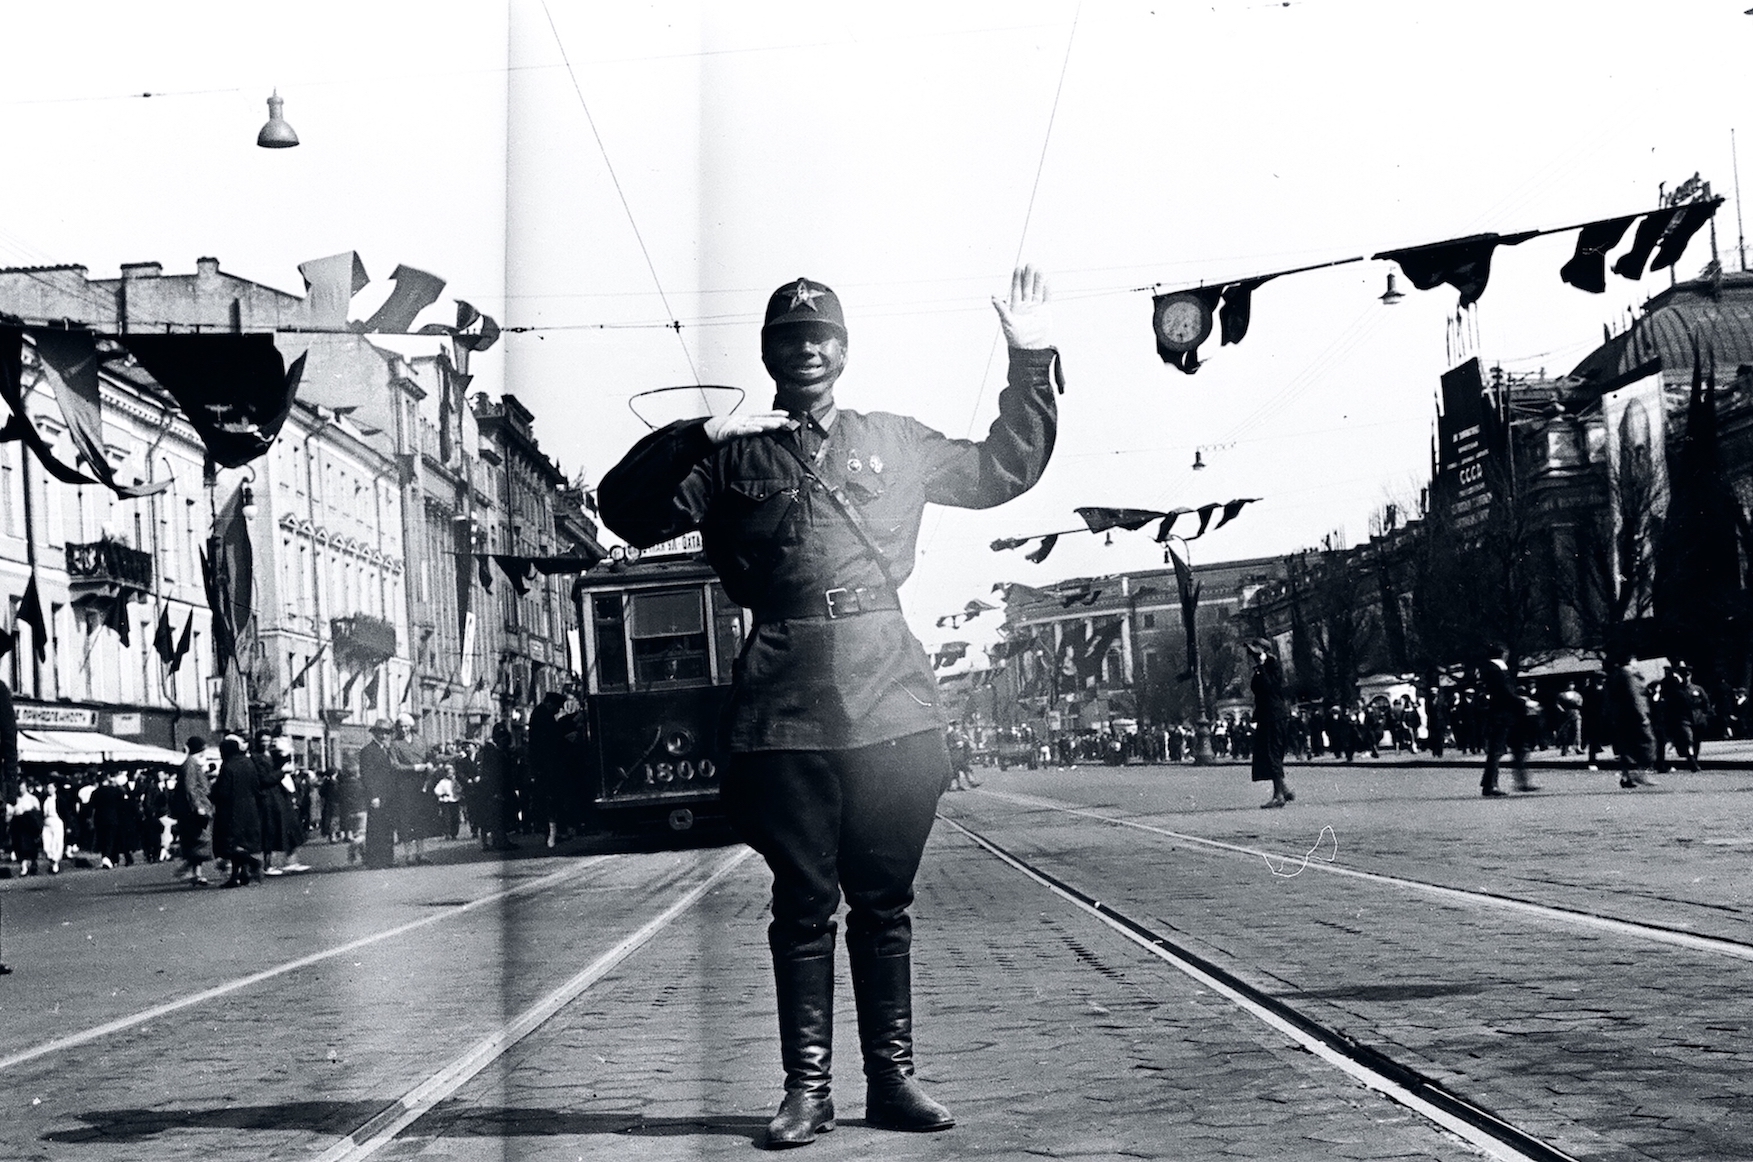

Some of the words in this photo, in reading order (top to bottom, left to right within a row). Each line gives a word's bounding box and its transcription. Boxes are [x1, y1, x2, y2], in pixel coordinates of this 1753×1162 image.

[1459, 463, 1483, 485] СССР
[682, 535, 701, 550] ОХТА
[644, 759, 716, 784] 1800
